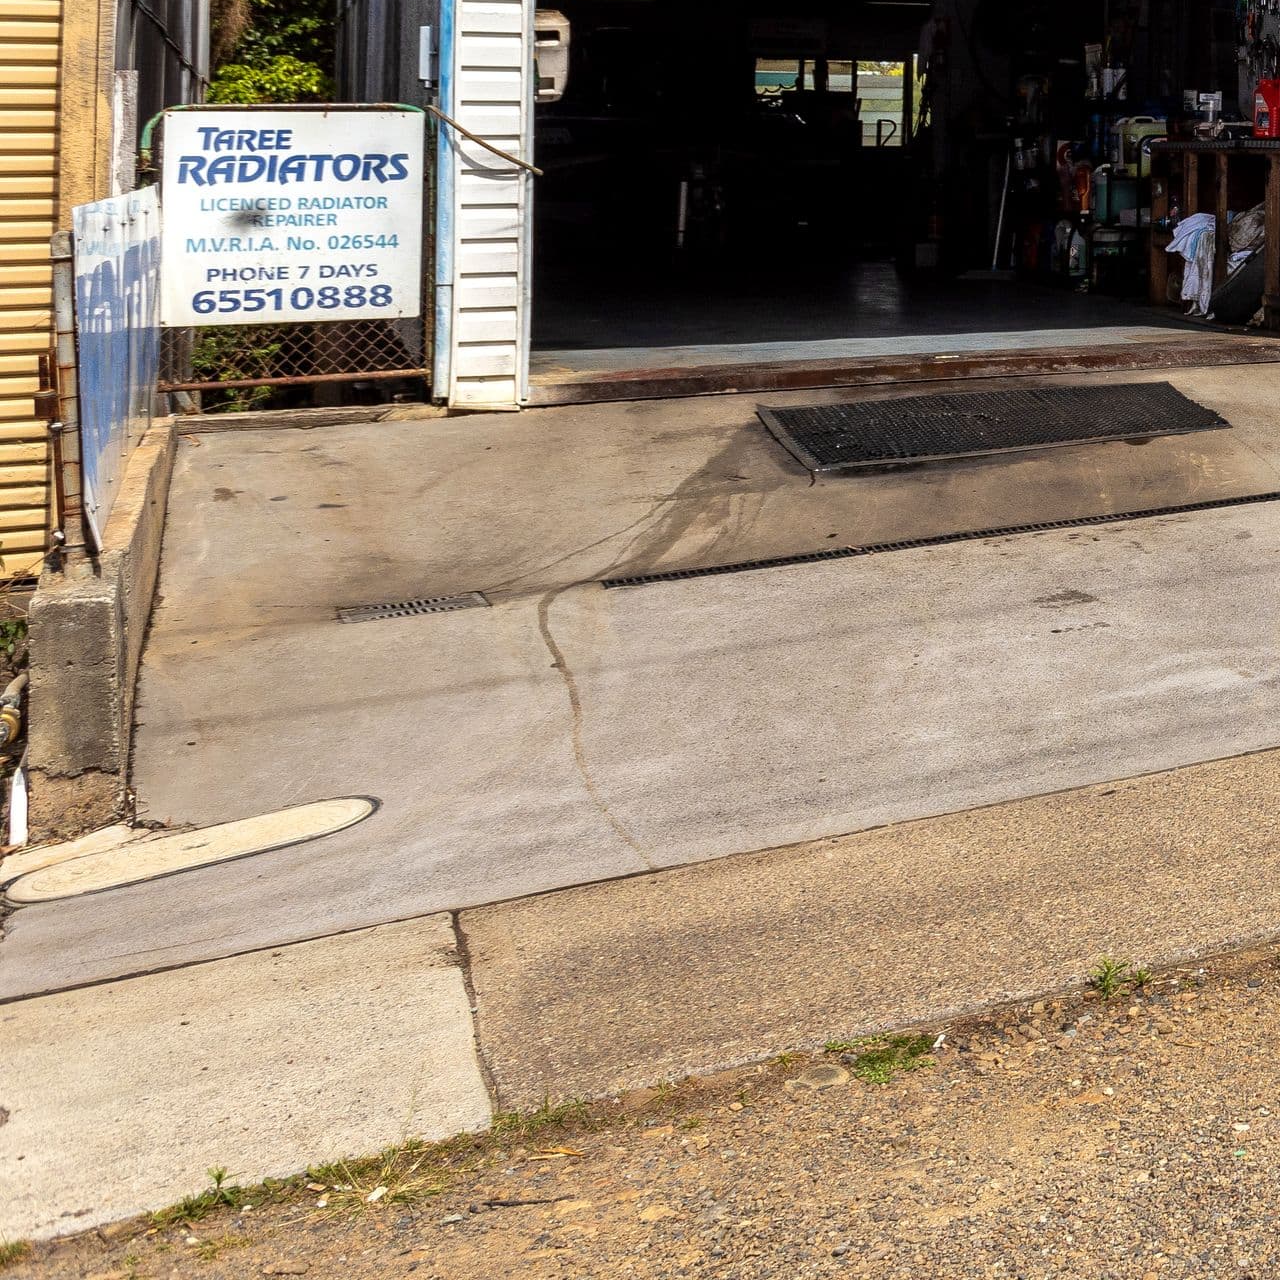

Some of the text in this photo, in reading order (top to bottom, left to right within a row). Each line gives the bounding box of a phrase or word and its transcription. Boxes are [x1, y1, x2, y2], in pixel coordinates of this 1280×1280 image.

[197, 126, 293, 153] TAREE
[177, 153, 409, 186] RADIATORS
[201, 196, 387, 211] LICENCED RADIATOR
[253, 213, 338, 227] REPAIRER
[186, 234, 399, 253] M.V.R.I.A. No. 026544
[206, 263, 378, 282] PHONE 7 DAYS
[192, 284, 393, 314] 65510888
